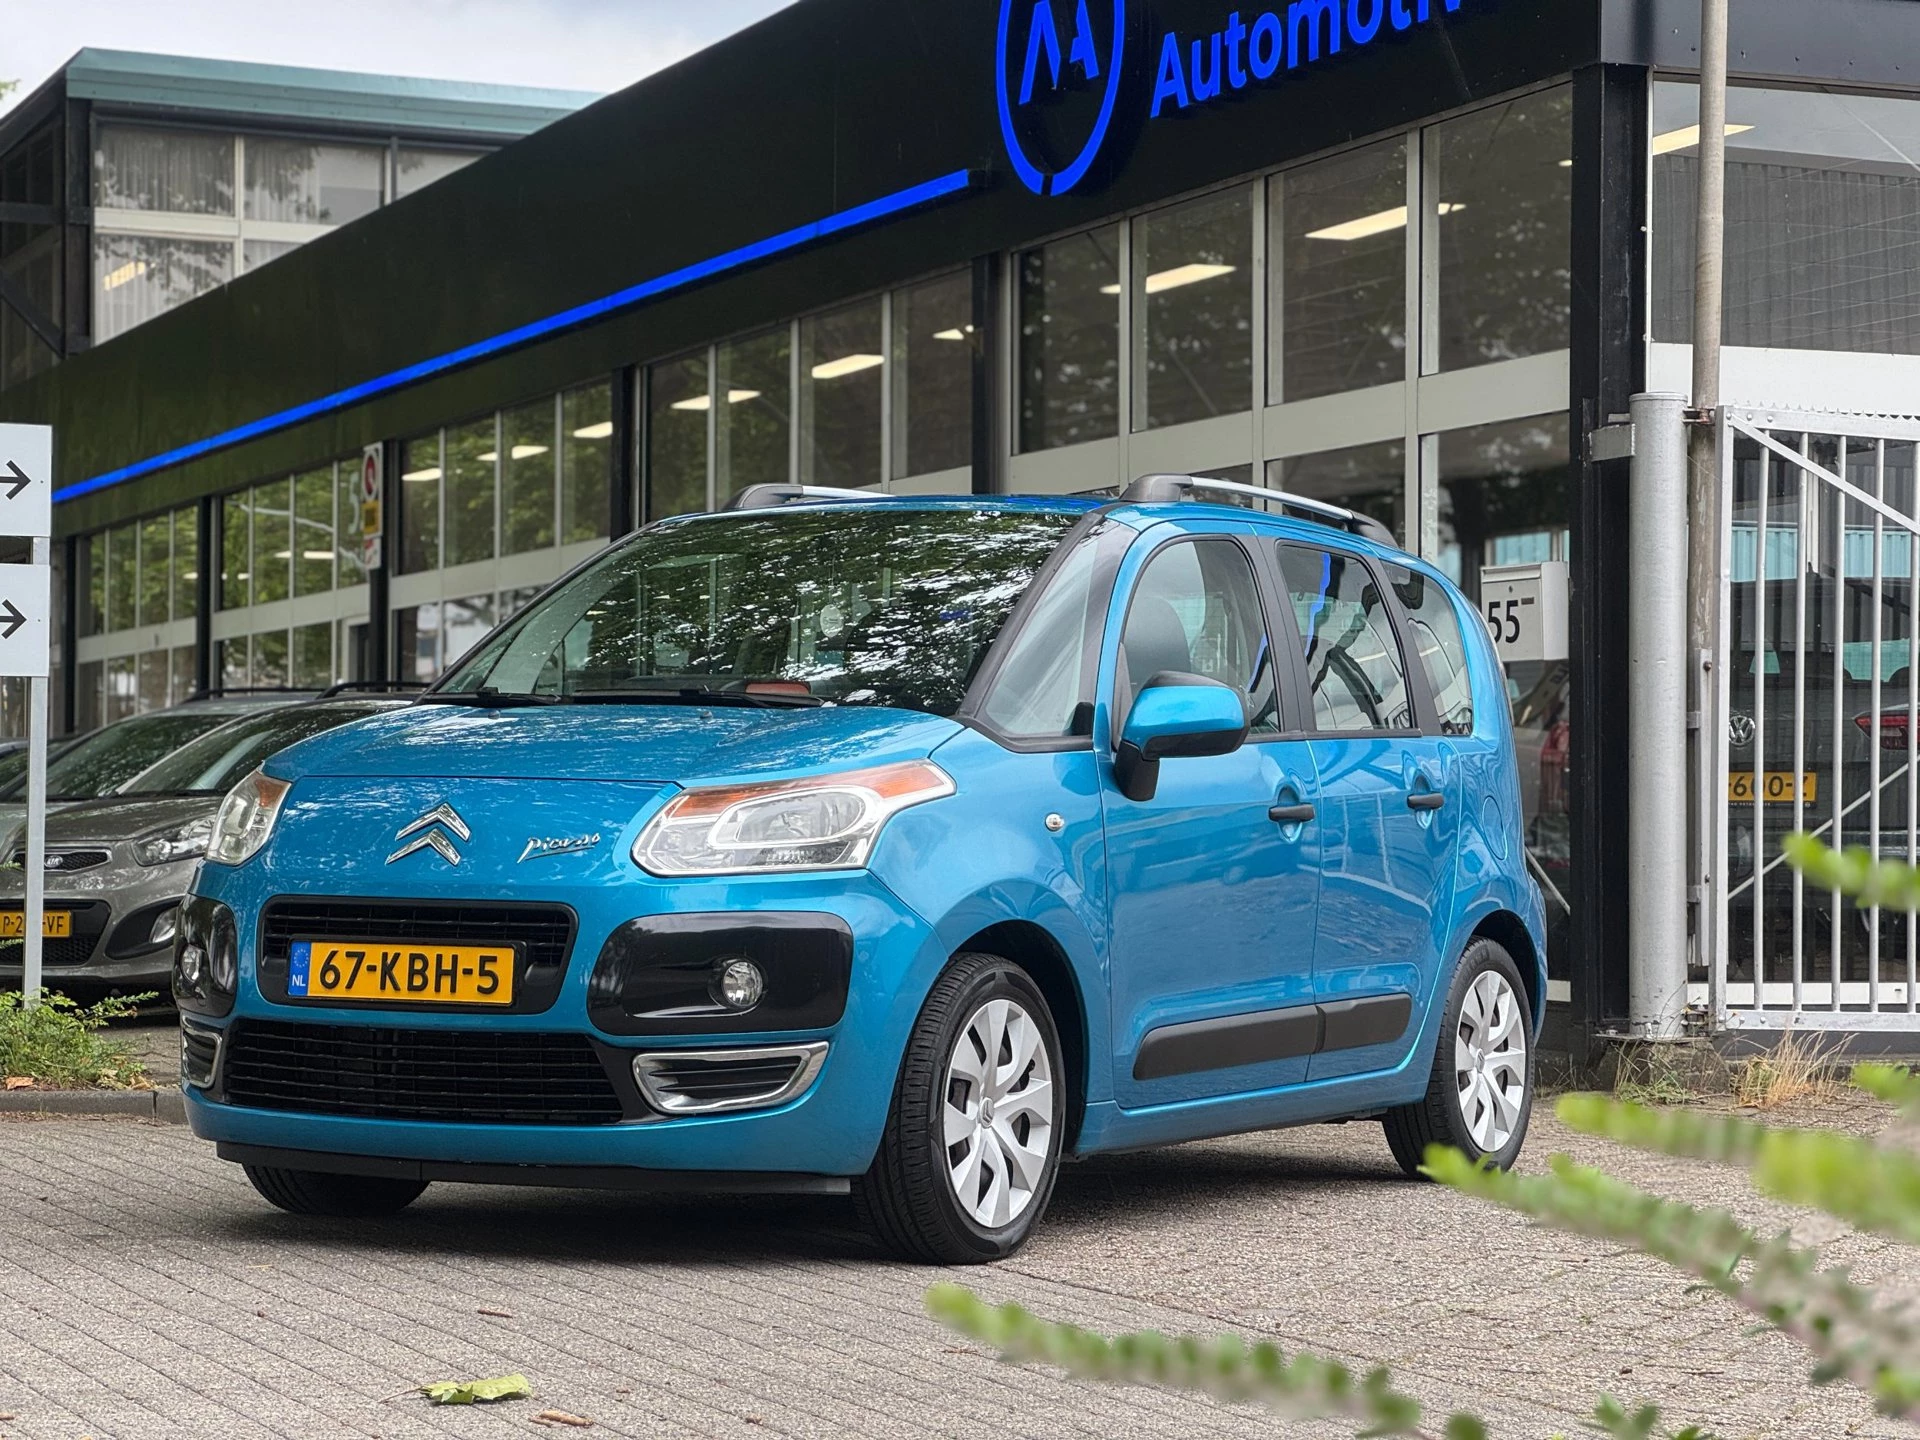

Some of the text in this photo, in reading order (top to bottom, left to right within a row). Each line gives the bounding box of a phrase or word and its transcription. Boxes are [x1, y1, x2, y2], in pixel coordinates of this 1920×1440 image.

[1150, 0, 1461, 119] Automo
[1488, 599, 1521, 644] 55
[2, 914, 65, 934] P-2-VF
[291, 974, 306, 987] NL
[319, 949, 500, 995] 67-KBH-5
